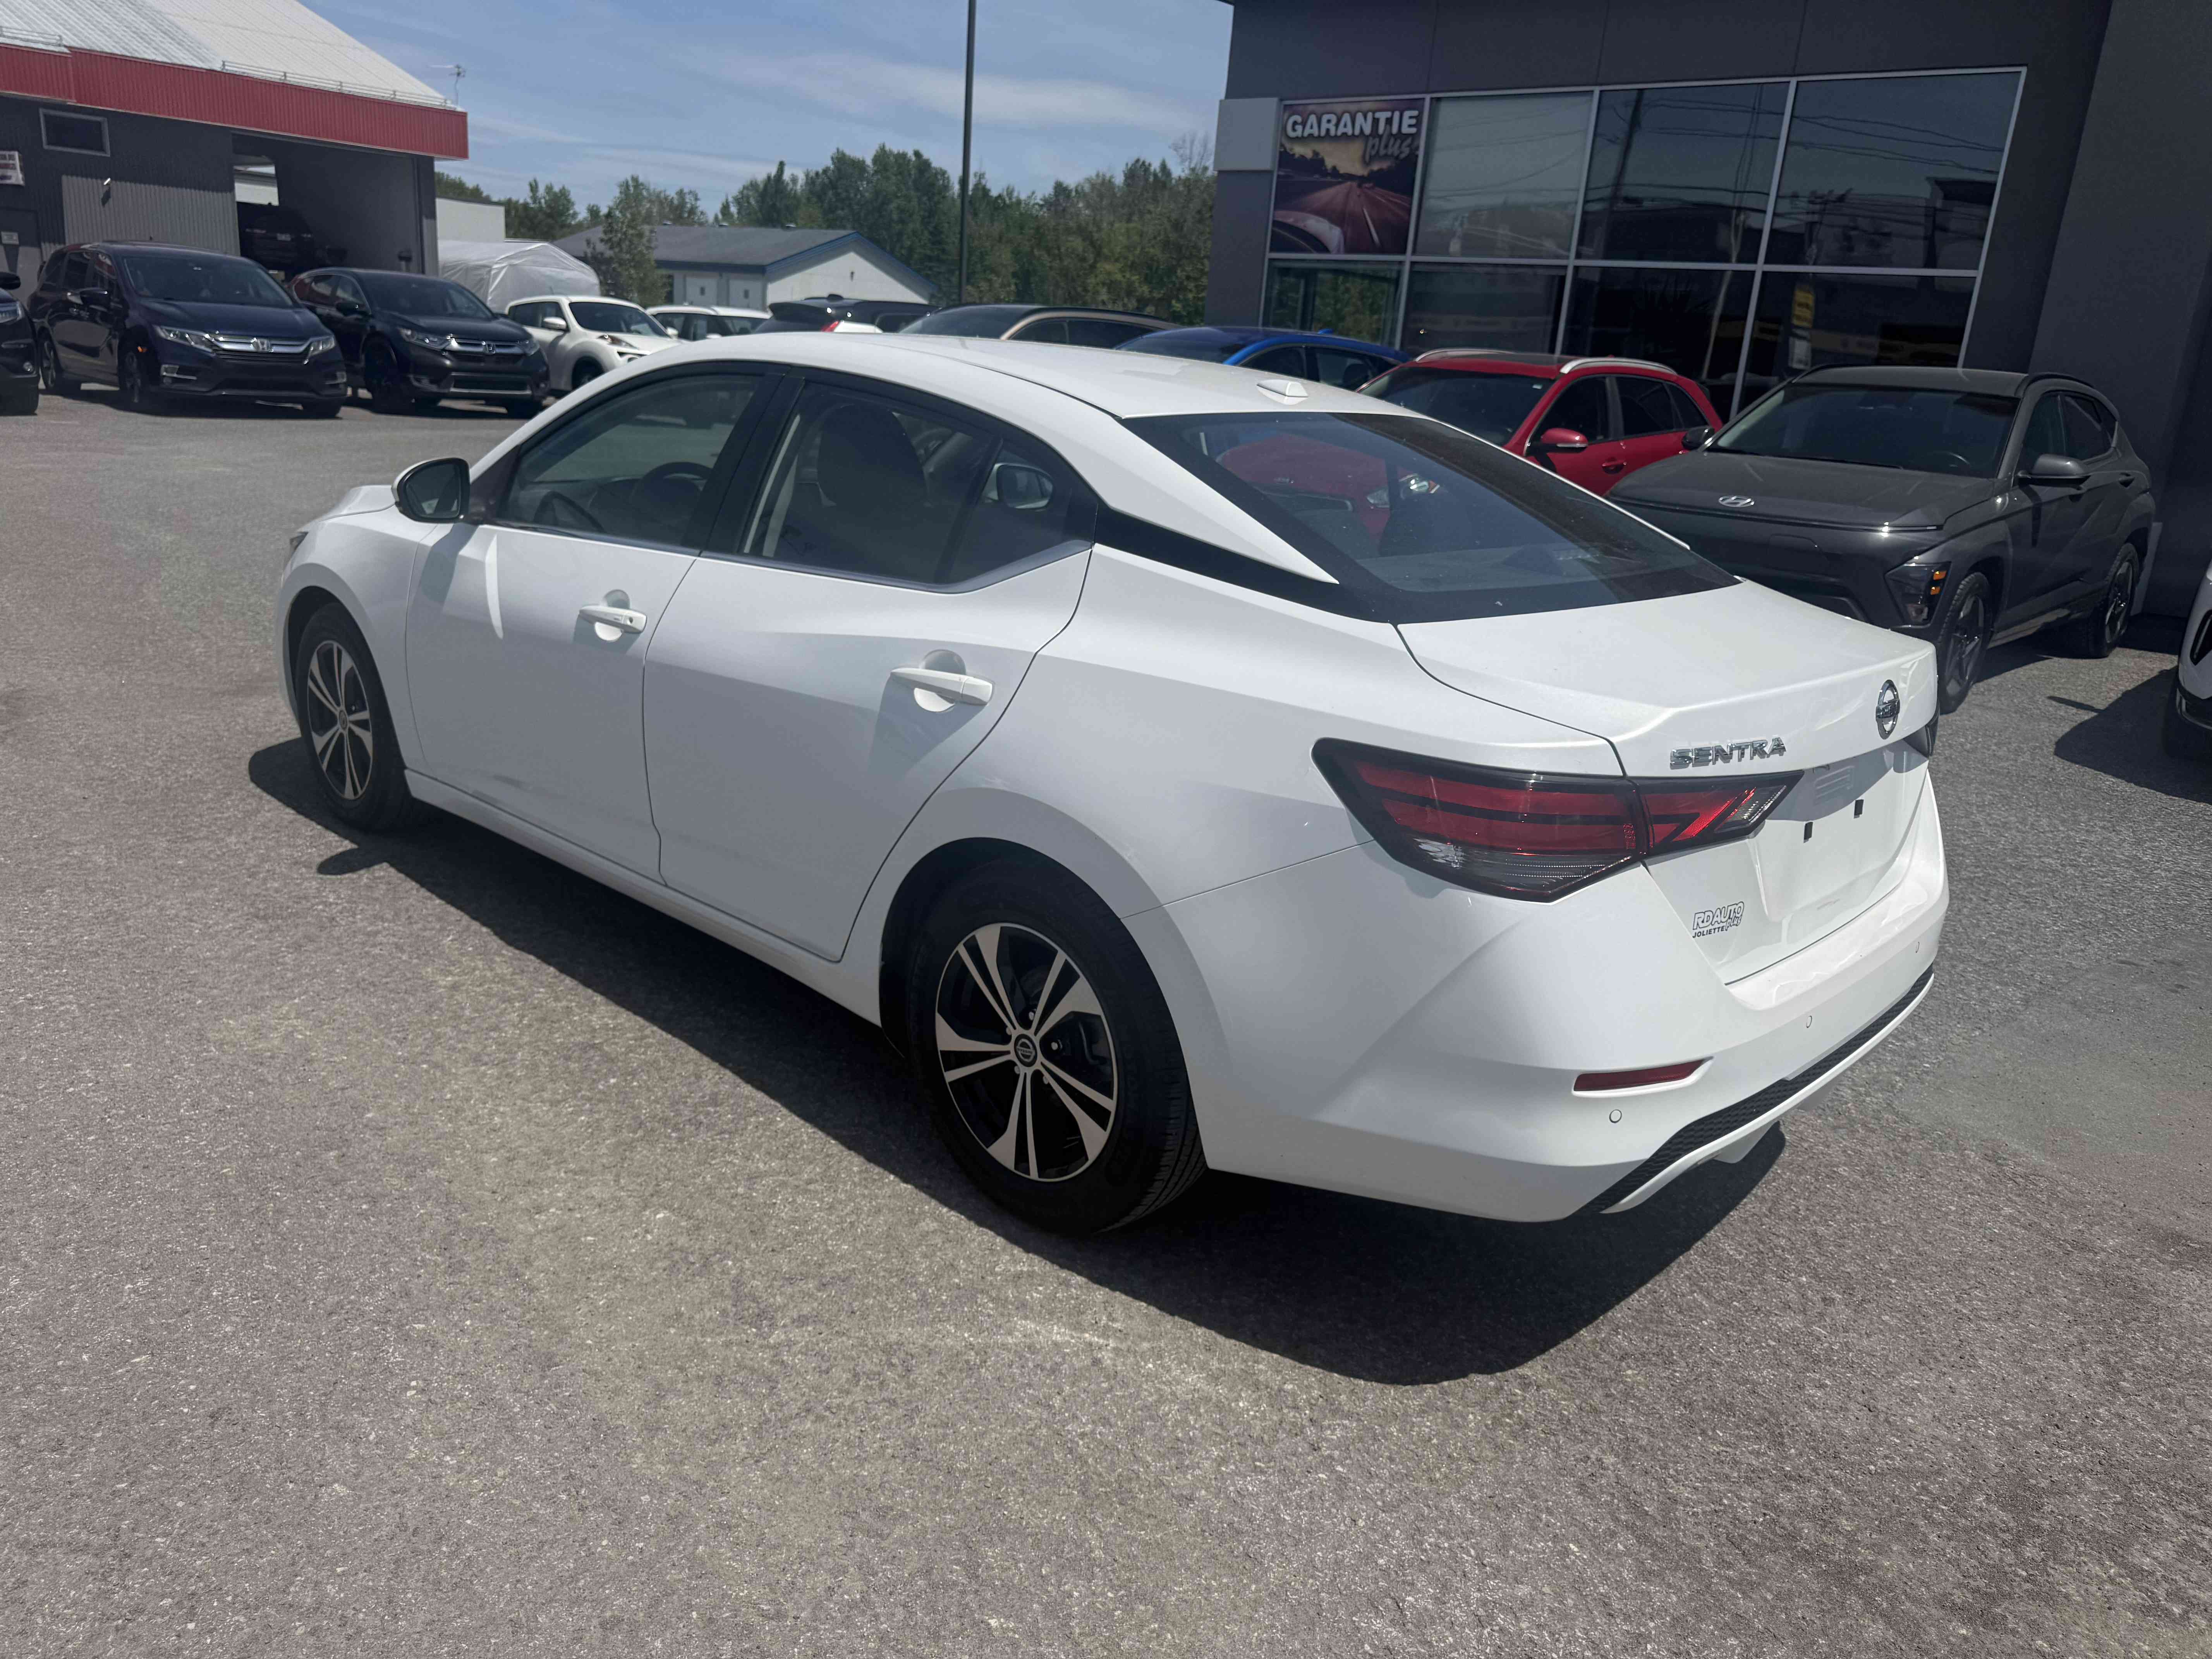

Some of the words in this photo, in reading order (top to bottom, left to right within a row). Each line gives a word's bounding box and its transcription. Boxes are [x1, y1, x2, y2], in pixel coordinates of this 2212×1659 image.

[1286, 110, 1419, 138] GARANTIE
[1364, 125, 1413, 163] plus
[1670, 737, 1786, 768] SENTRA
[1692, 926, 1725, 938] JOLIETTE
